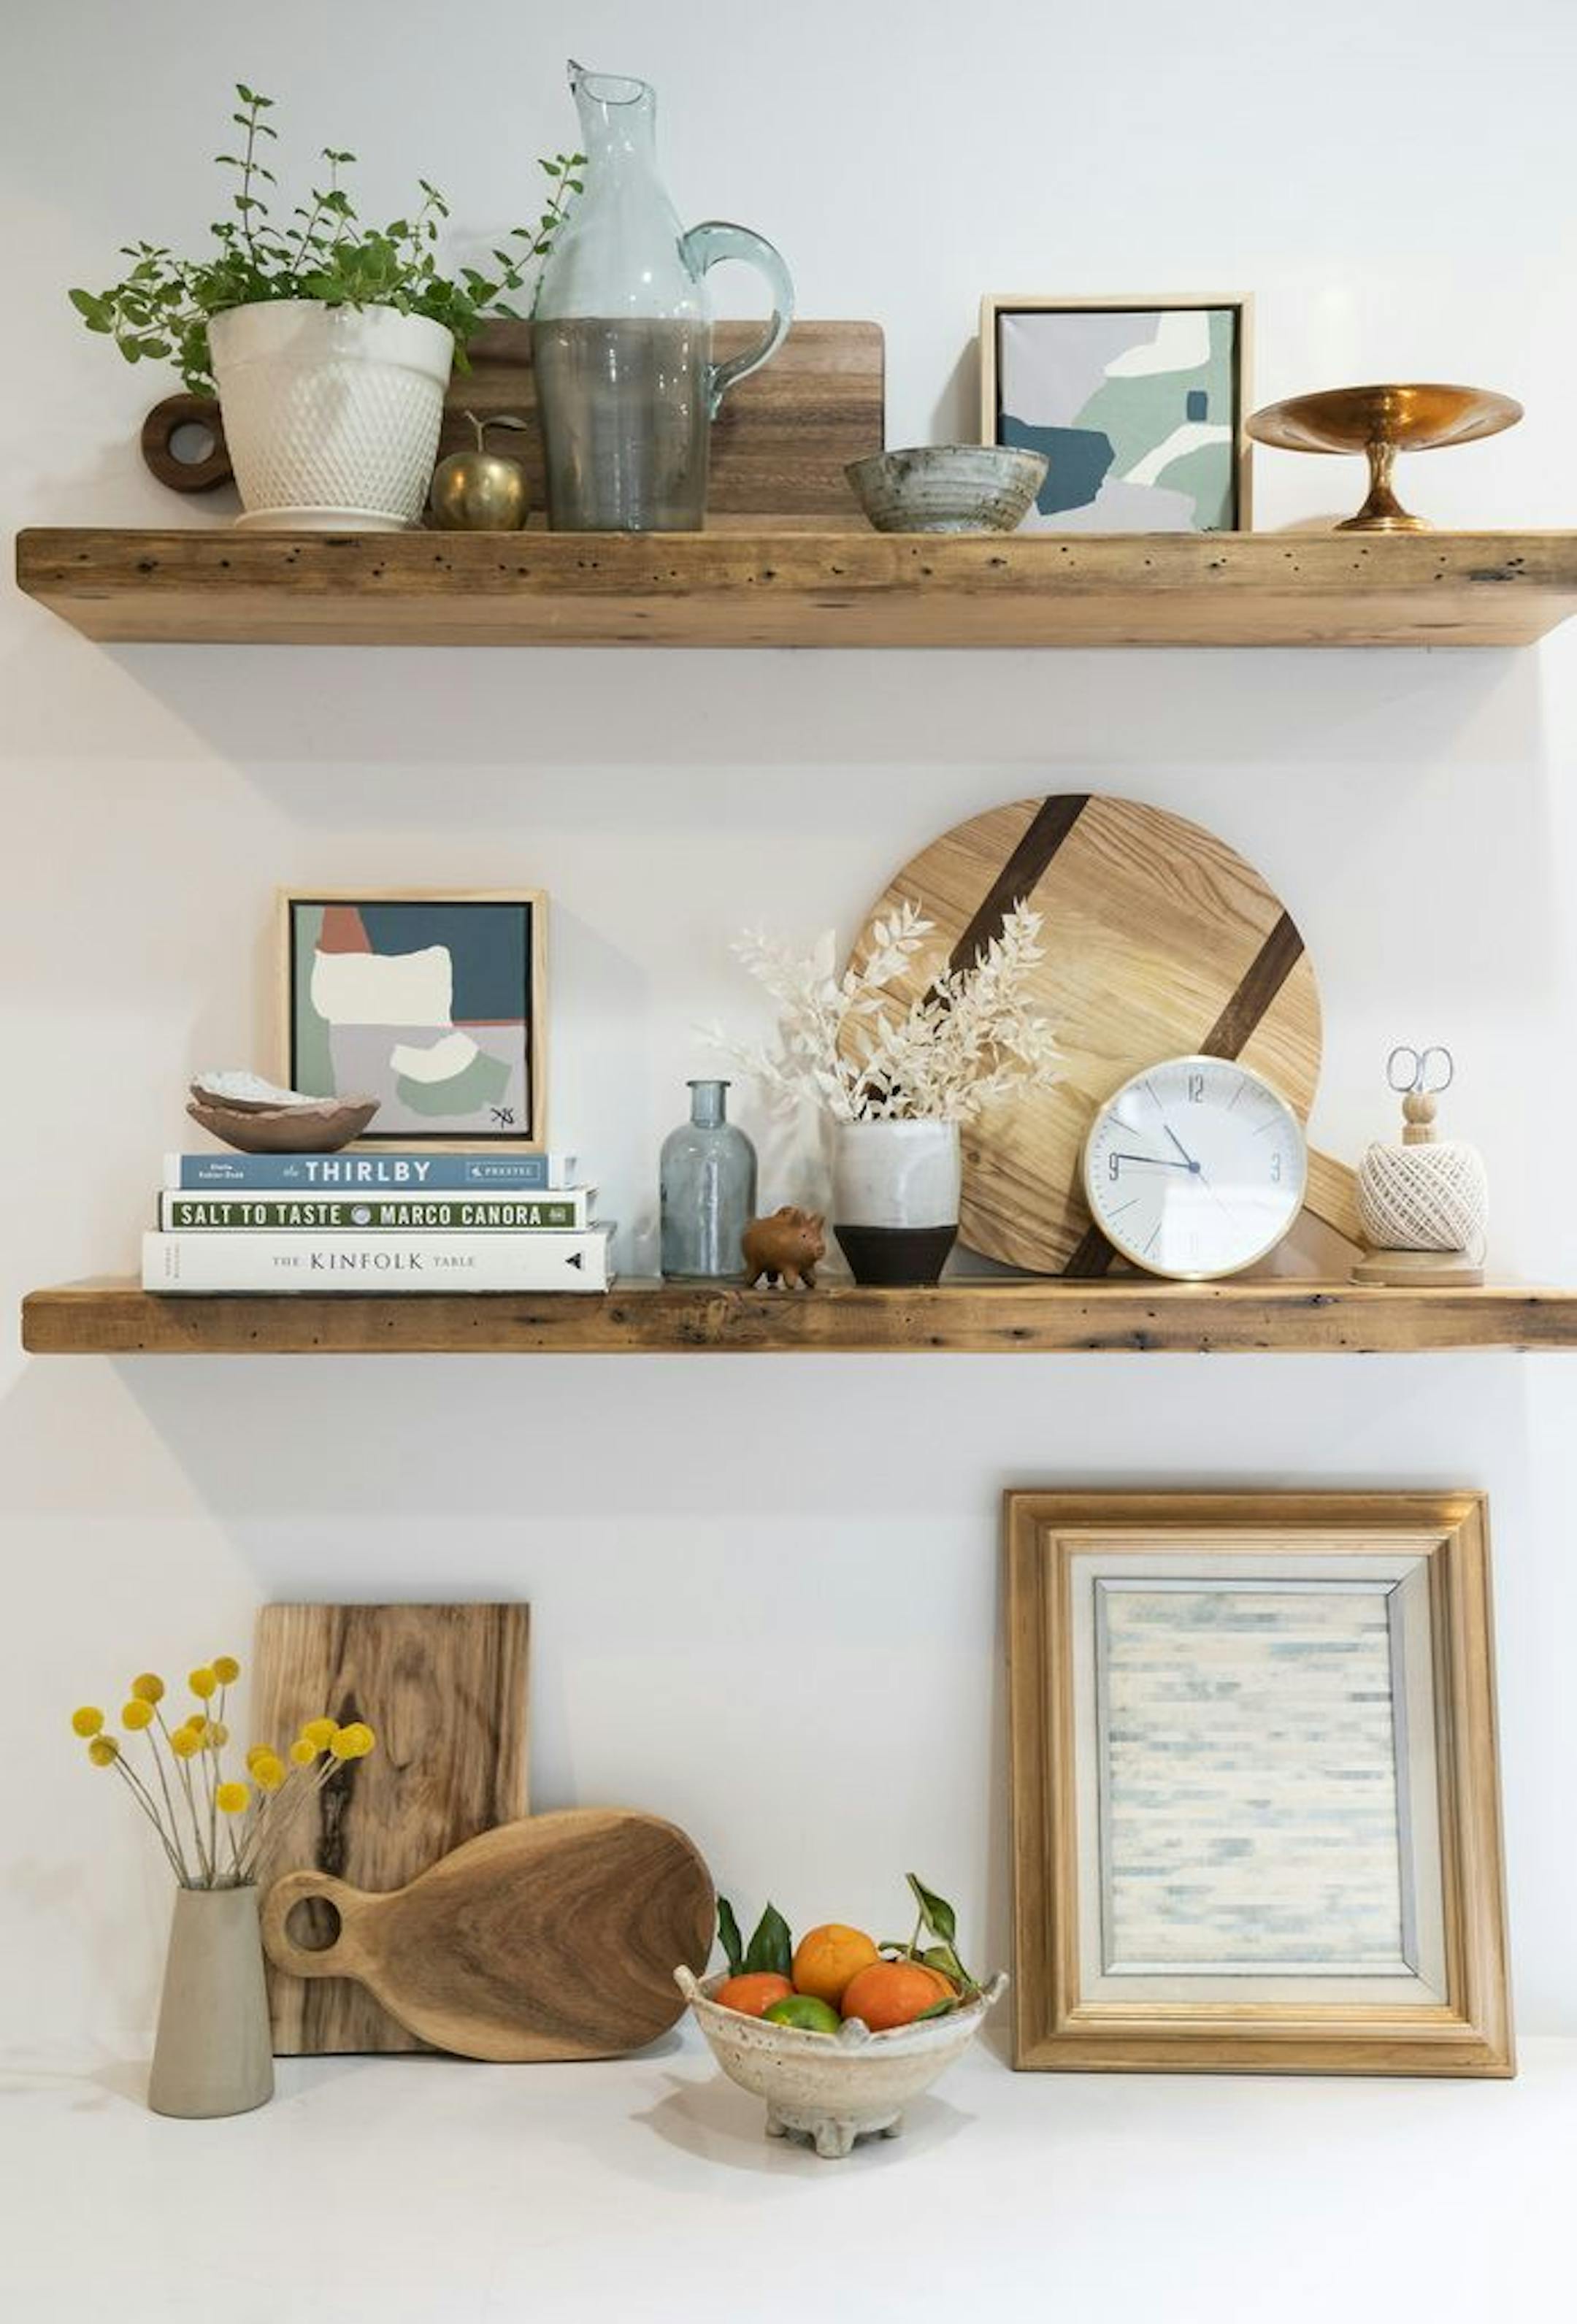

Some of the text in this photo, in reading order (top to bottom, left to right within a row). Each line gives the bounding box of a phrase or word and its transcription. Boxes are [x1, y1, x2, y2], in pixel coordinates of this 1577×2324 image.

[1189, 1073, 1204, 1103] 12
[306, 1162, 430, 1181] THIRLBY
[1108, 1152, 1119, 1181] 9
[1270, 1152, 1281, 1181] 3
[181, 1205, 231, 1224] SALT
[241, 1205, 266, 1224] TO
[276, 1205, 341, 1224] TASTE
[380, 1205, 450, 1224] MARCO
[461, 1205, 541, 1224] CANORA
[310, 1253, 423, 1269] KINFOLK
[433, 1257, 474, 1267] TABLE
